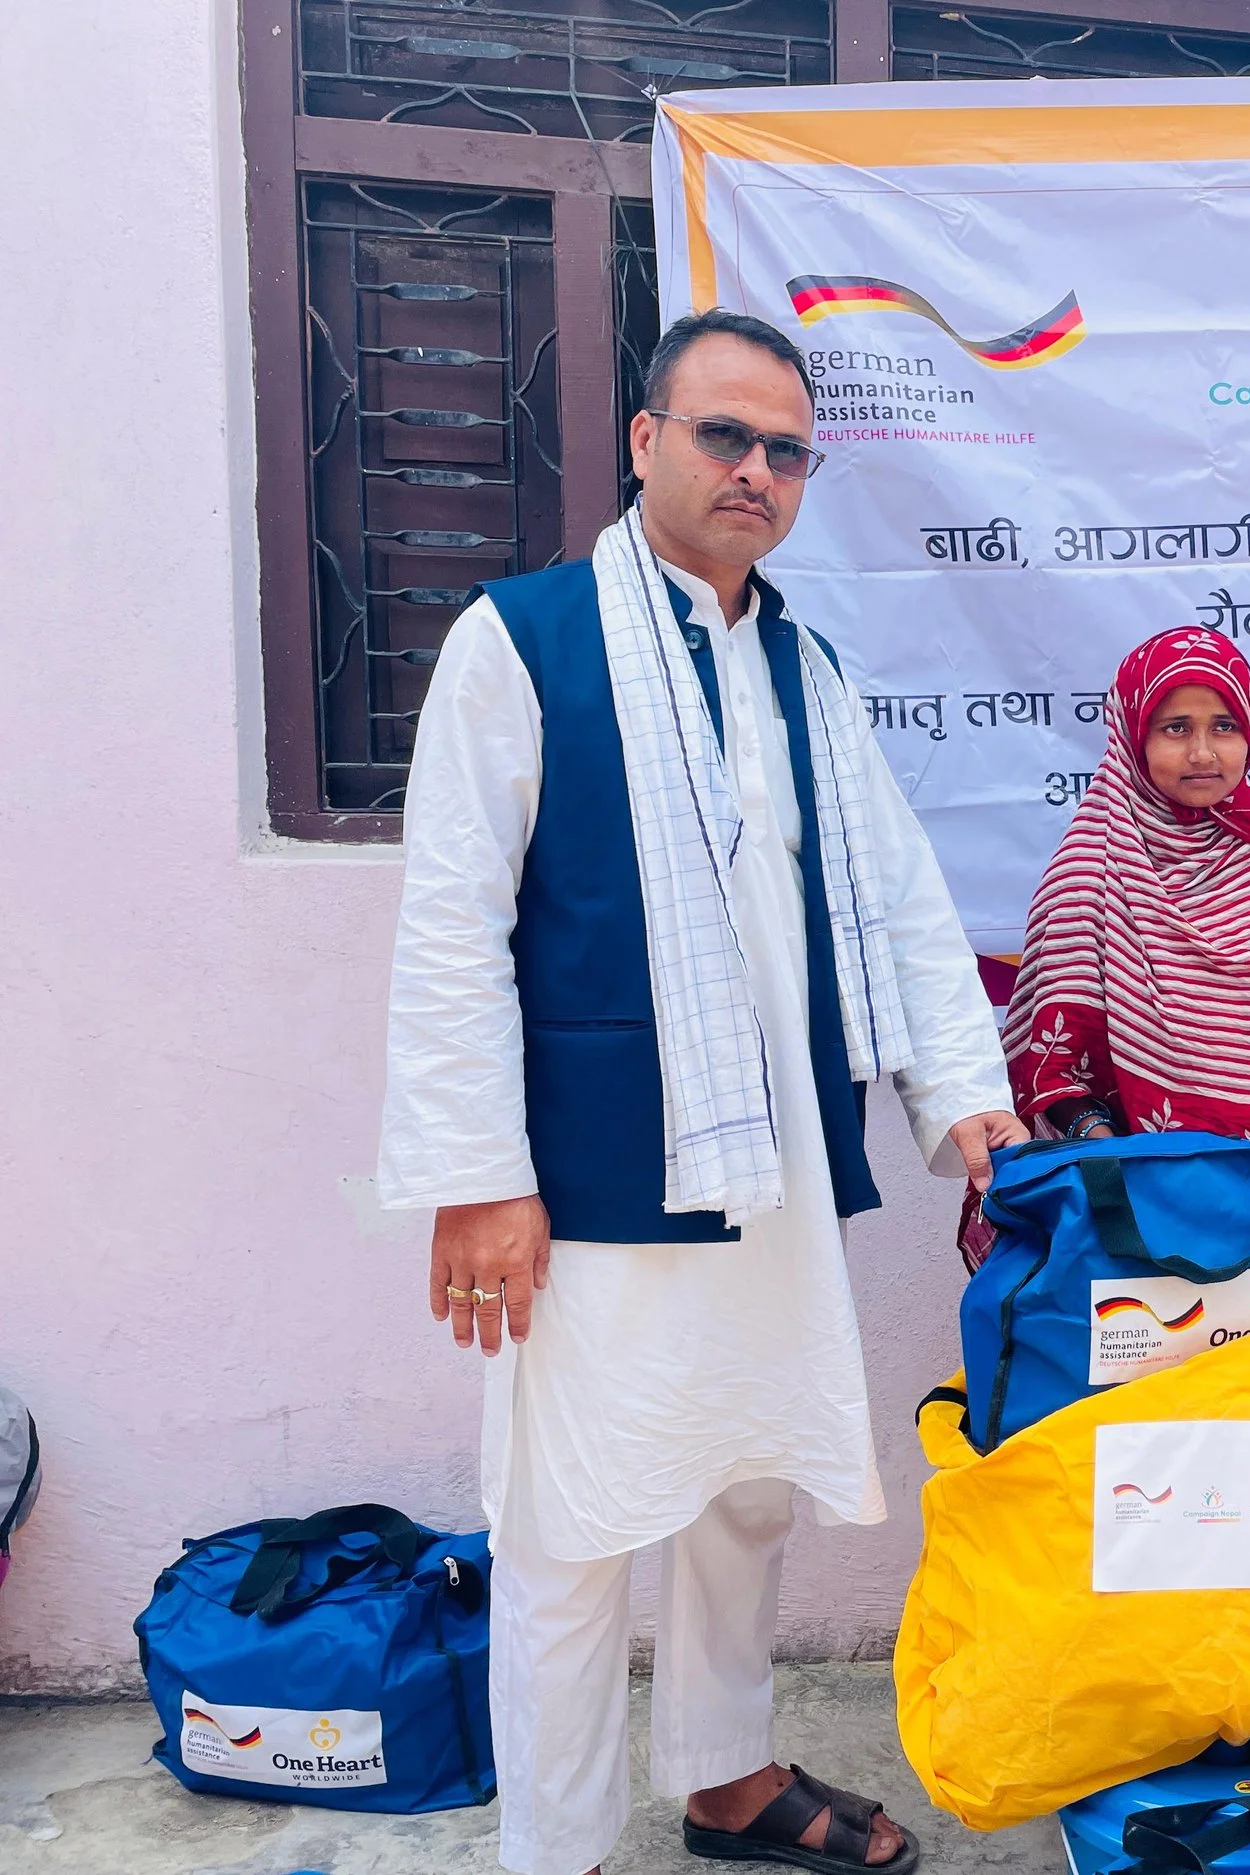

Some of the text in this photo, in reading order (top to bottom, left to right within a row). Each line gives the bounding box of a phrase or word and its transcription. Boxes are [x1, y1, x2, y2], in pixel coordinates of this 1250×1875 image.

[809, 350, 936, 378] german
[811, 380, 974, 404] humanitarian
[816, 401, 936, 423] assistance
[818, 429, 1037, 444] DEUTSCHE HUMANITÄRE HILFE
[919, 516, 1029, 569] बाढी,
[859, 695, 948, 741] मातृ
[963, 691, 1055, 727] तथा
[1100, 1329, 1149, 1341] german
[1100, 1340, 1162, 1350] humanitarian
[1100, 1351, 1148, 1359] assistance
[1183, 1510, 1219, 1518] Campaign
[188, 1730, 221, 1744] german
[187, 1739, 230, 1756] humanitarian
[187, 1747, 220, 1760] assistance
[272, 1753, 383, 1772] One Heart
[293, 1774, 361, 1782] WORLDWIDE
